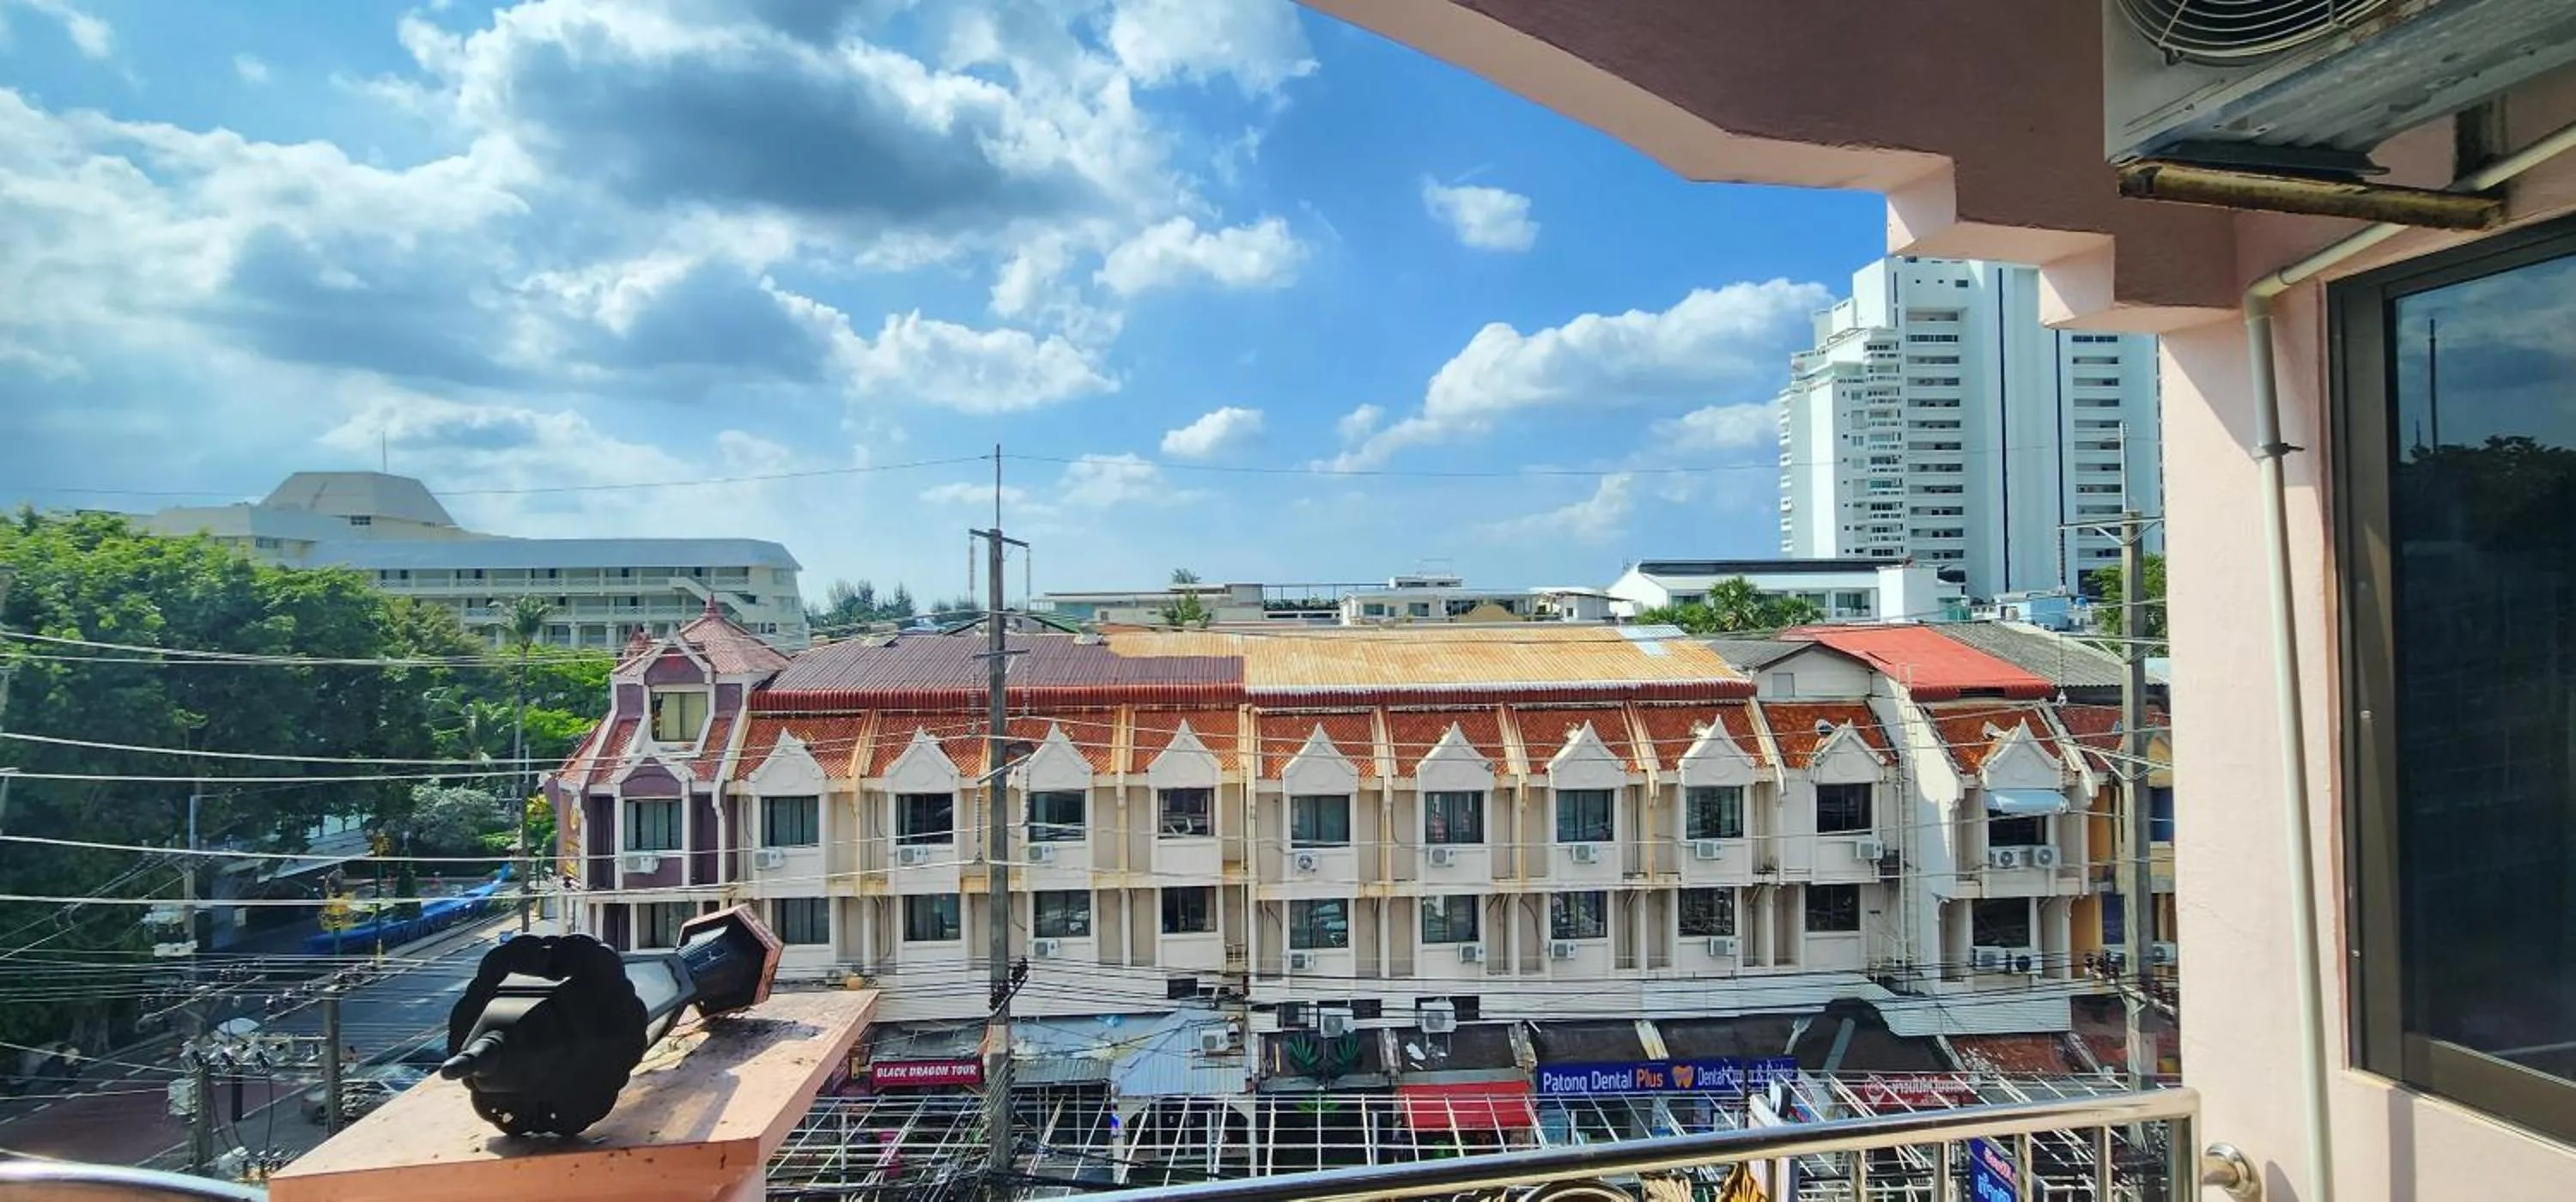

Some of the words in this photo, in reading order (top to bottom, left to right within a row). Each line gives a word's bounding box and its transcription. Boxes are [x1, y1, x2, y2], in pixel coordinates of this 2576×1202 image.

[877, 1067, 907, 1078] BLACK
[909, 1065, 948, 1077] DRAGON
[951, 1065, 976, 1076] TOUR
[1543, 1071, 1587, 1093] Patong
[1591, 1070, 1632, 1090] Dental
[1636, 1068, 1663, 1088] Plus
[1698, 1066, 1725, 1086] Dental
